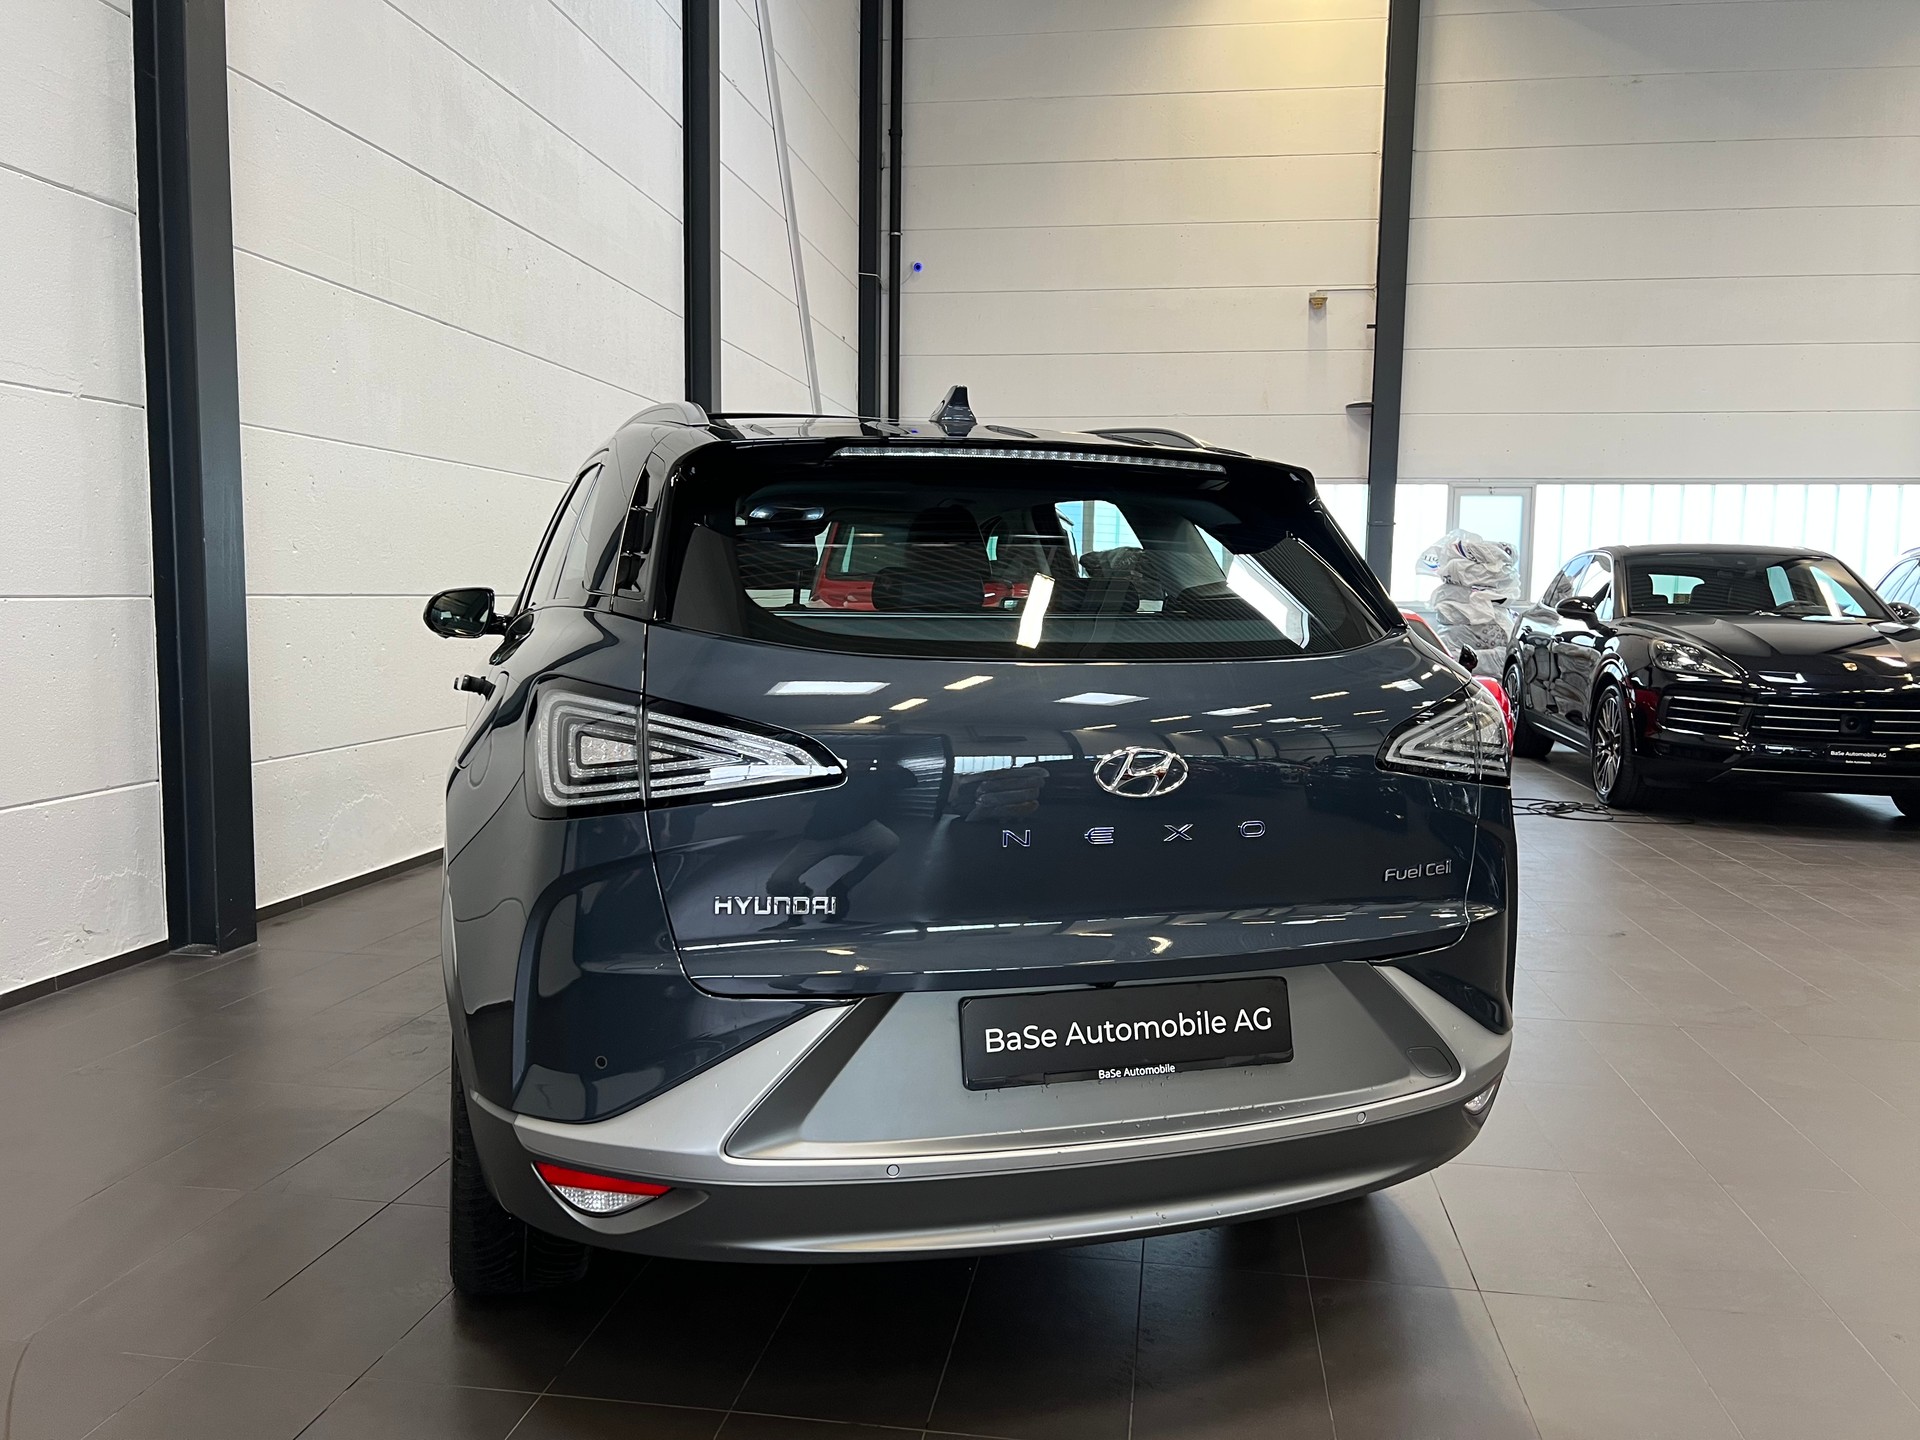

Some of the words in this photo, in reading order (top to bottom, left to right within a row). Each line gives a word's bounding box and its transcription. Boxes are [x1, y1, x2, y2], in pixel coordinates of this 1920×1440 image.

[1002, 820, 1266, 848] NEXO
[1384, 863, 1422, 882] Fuel
[714, 896, 837, 915] HYUNDAI
[985, 1025, 1058, 1053] BaSe
[1065, 1010, 1227, 1046] Automobile
[1234, 1007, 1272, 1032] AG
[1098, 1068, 1122, 1079] BaSe
[1123, 1063, 1176, 1077] Automobile
